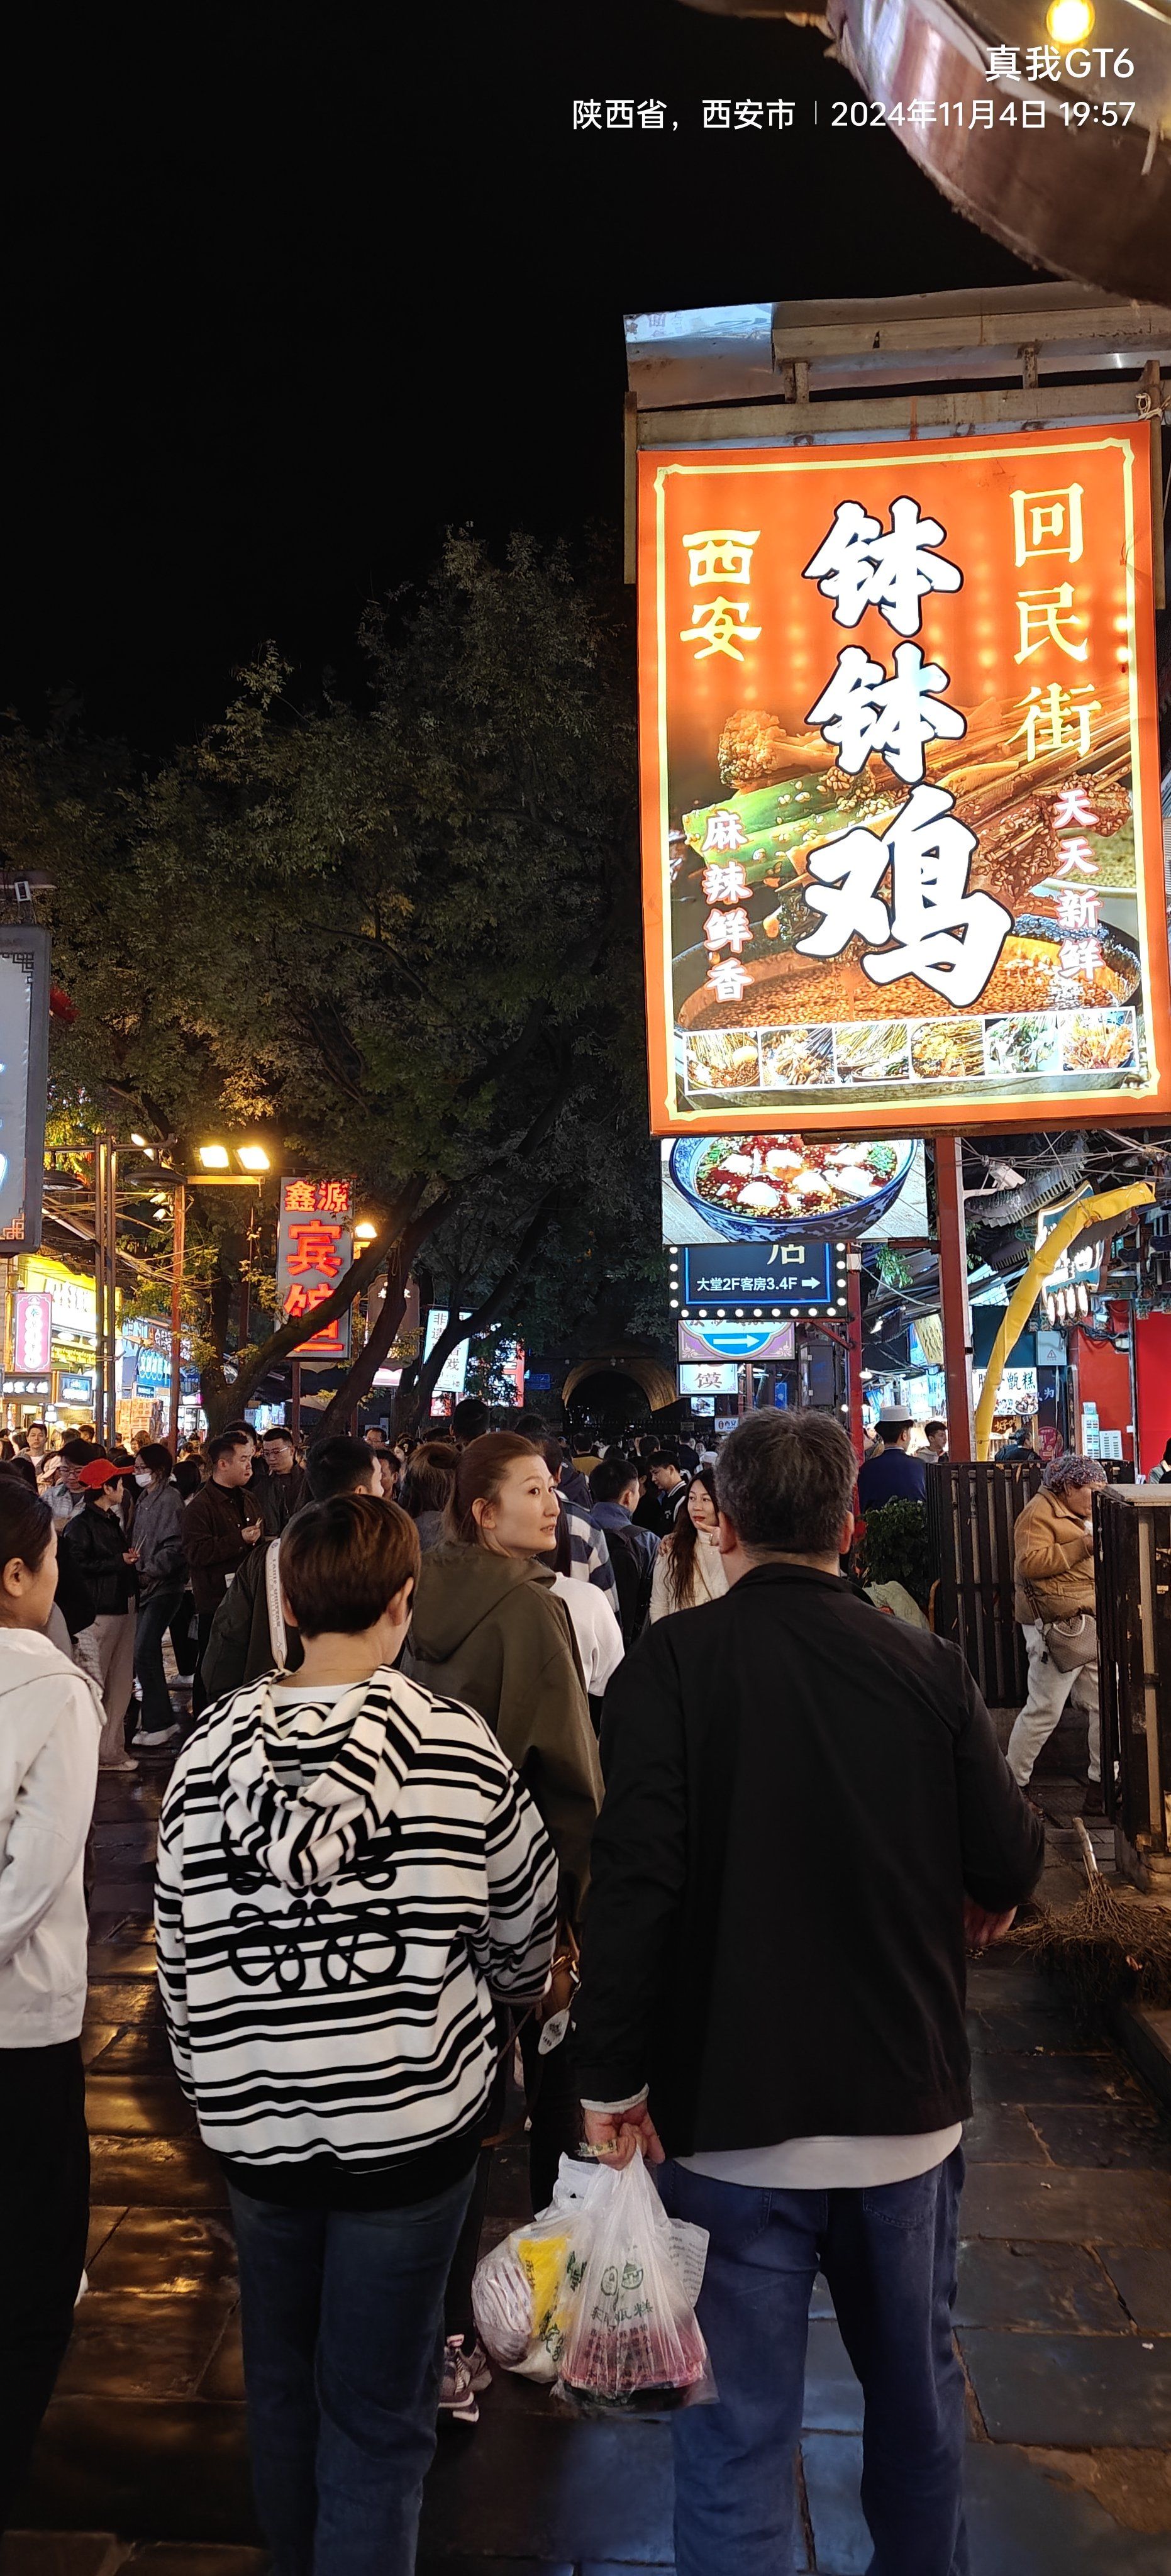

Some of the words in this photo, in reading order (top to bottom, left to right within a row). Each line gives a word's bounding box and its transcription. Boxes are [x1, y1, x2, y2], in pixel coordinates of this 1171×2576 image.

[680, 530, 762, 662] 西安
[1009, 482, 1102, 762] 回民街
[795, 495, 1014, 1006] 钵钵鸡
[701, 809, 755, 1003] 麻辣鲜香
[1053, 788, 1106, 982] 天天新鲜
[284, 1180, 349, 1212] 鑫源
[697, 1277, 797, 1292] 大堂2F客房3.4F
[694, 1372, 723, 1389] 馍
